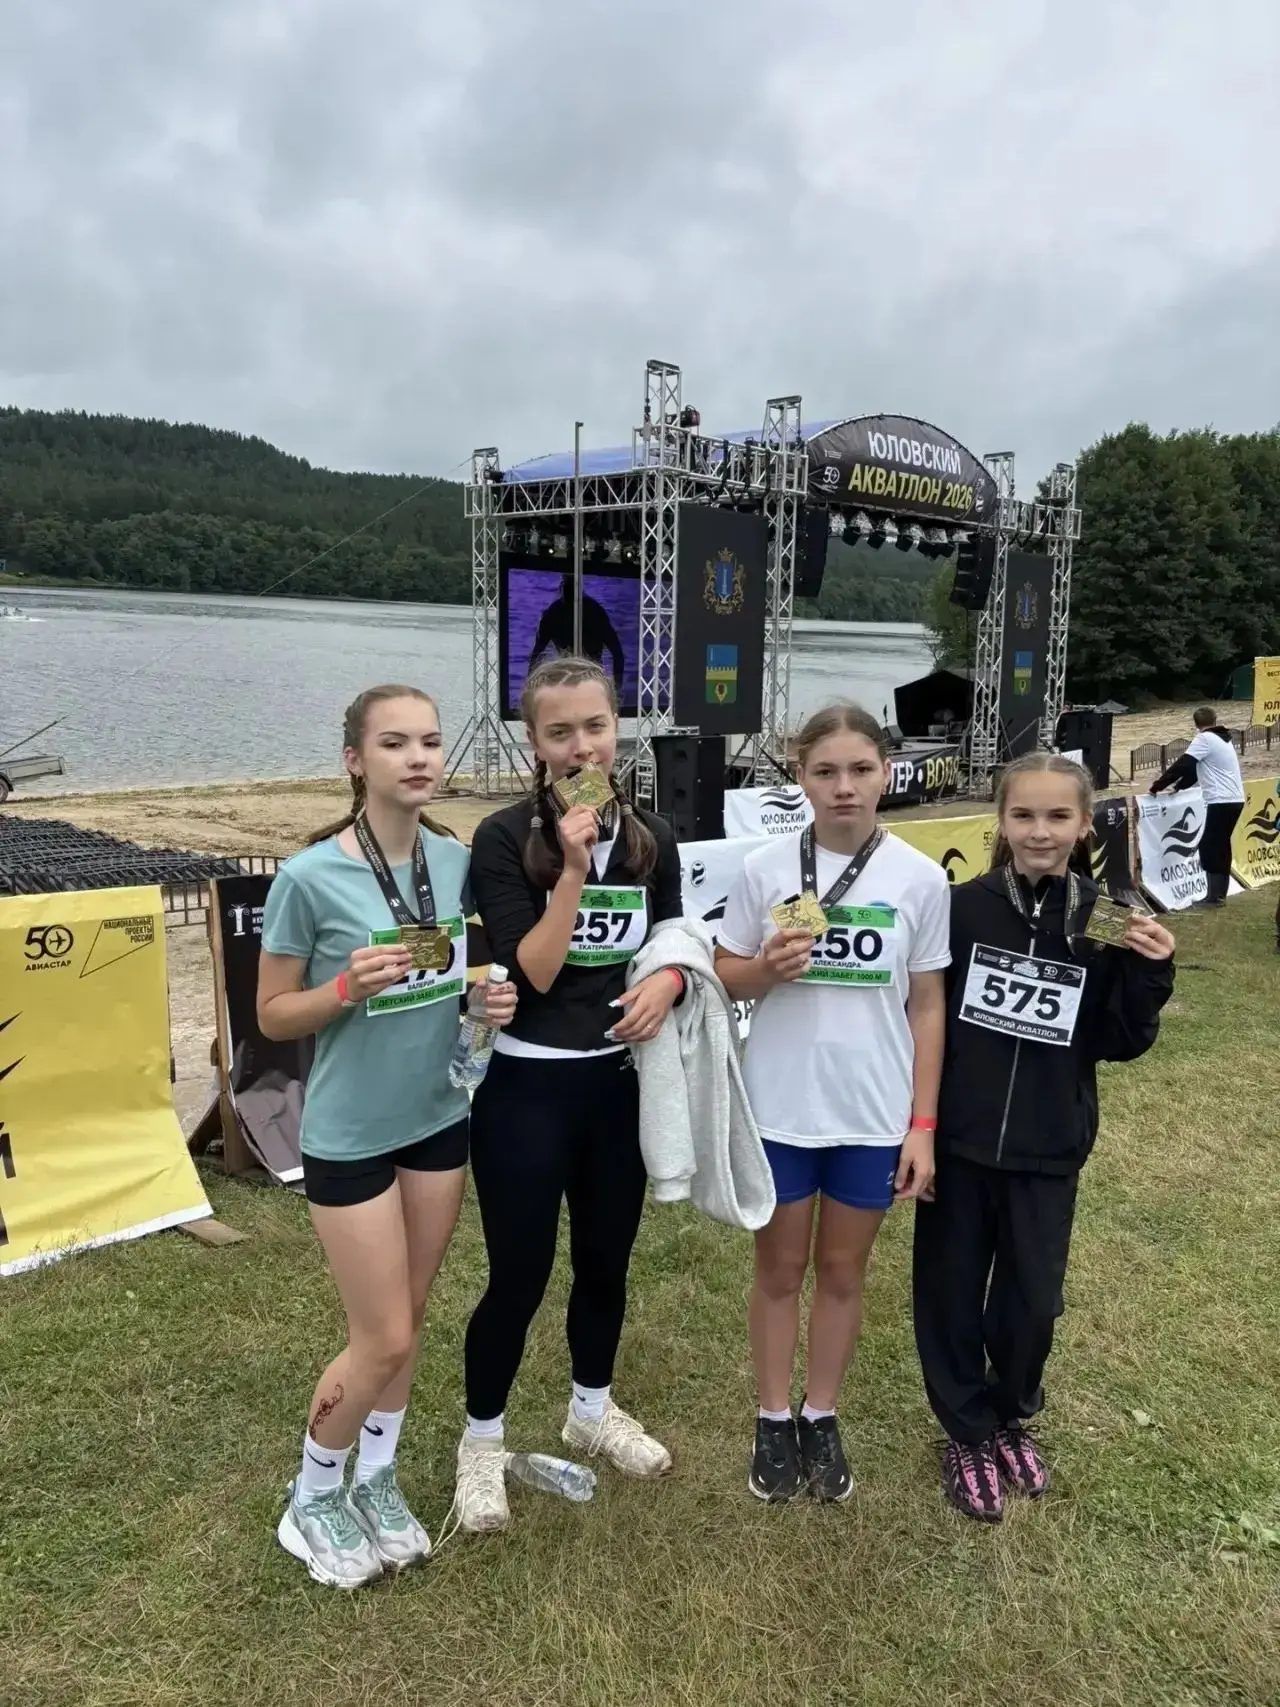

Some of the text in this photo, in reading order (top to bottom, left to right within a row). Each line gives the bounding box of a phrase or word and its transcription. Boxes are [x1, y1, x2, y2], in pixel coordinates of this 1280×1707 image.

[867, 431, 962, 476] ЮЛОВСКИЙ
[848, 463, 973, 511] АКВАТЛОН 2026
[761, 810, 807, 825] ЮЛОВСКИЙ
[104, 918, 152, 930] НАЦИОНАЛЬНЫЕ
[571, 911, 633, 944] 257
[125, 926, 152, 936] ПРОЕКТЫ
[24, 924, 74, 960] 50
[130, 934, 152, 944] РОССИИ
[578, 943, 614, 951] ЕКАТЕРИНА
[25, 960, 72, 971] АВИАСТАР
[813, 960, 862, 969] АЛЕКСАНДРА
[830, 971, 853, 979] ЗАБЕГ
[407, 979, 435, 991] ВАЛЕРИЯ
[378, 993, 415, 1007] ДЕТСКИЙ
[980, 973, 1061, 1022] 575
[973, 1011, 1058, 1039] ЮЛОВСКИЙ АКВАТЛОН
